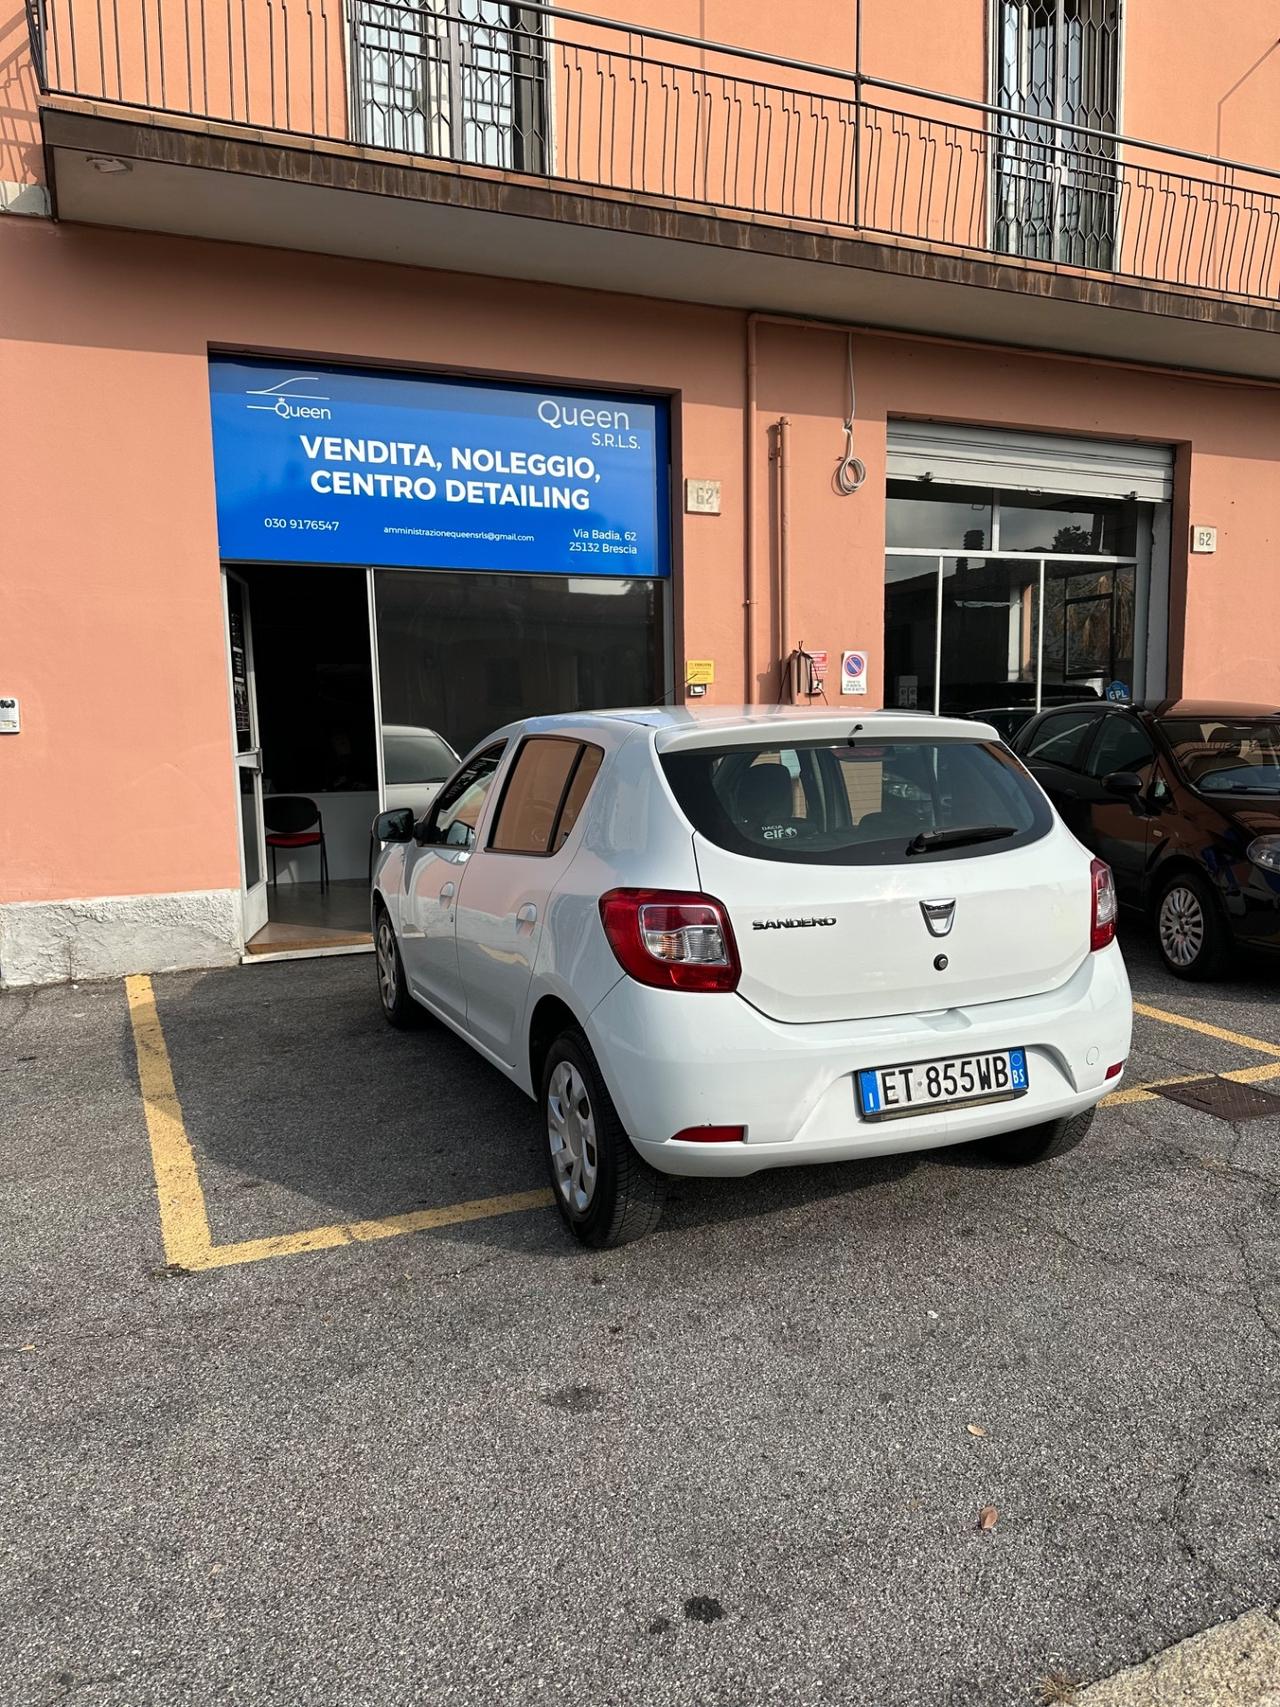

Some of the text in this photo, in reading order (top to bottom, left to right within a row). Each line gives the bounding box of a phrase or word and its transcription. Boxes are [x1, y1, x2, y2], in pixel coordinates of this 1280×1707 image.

[275, 401, 331, 420] Queen
[537, 400, 630, 430] Queen
[591, 432, 641, 449] S.R.L.S.
[299, 435, 601, 483] VENDITA, NOLEGGIO,
[310, 470, 590, 511] CENTRO DETAILING
[696, 487, 714, 505] 62
[264, 517, 340, 531] 030 9176547
[383, 526, 535, 542] amministrazionequeensrls@gmail.com
[573, 528, 637, 541] Via Badia, 62
[1199, 532, 1212, 546] 62
[569, 541, 637, 554] 25132 Brescia
[1109, 690, 1128, 700] GPL
[763, 829, 785, 839] elf
[752, 916, 838, 931] SANDERO
[880, 1068, 914, 1106] ET
[925, 1055, 1009, 1099] 855WB
[1011, 1067, 1025, 1084] BS
